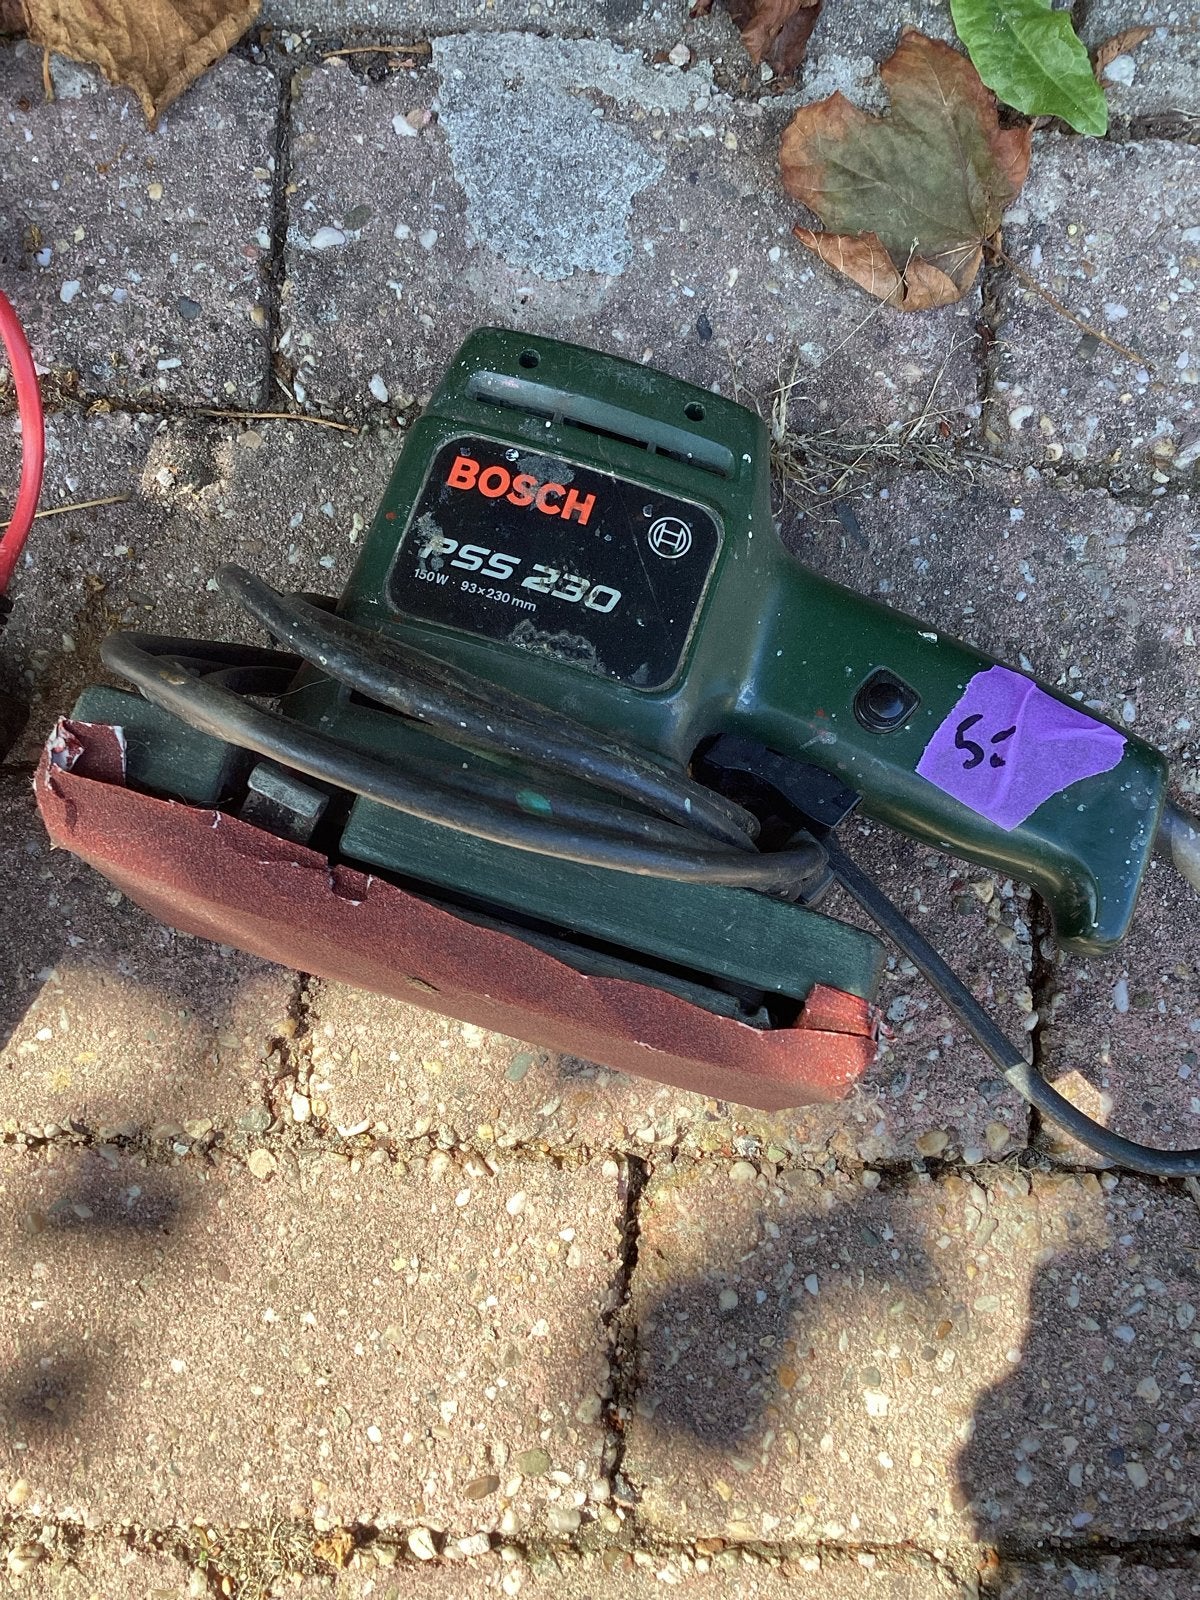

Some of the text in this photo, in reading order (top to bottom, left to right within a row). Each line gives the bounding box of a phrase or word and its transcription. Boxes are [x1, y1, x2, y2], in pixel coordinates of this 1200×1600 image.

[447, 455, 597, 526] BOSCH
[419, 537, 622, 613] PSS 230
